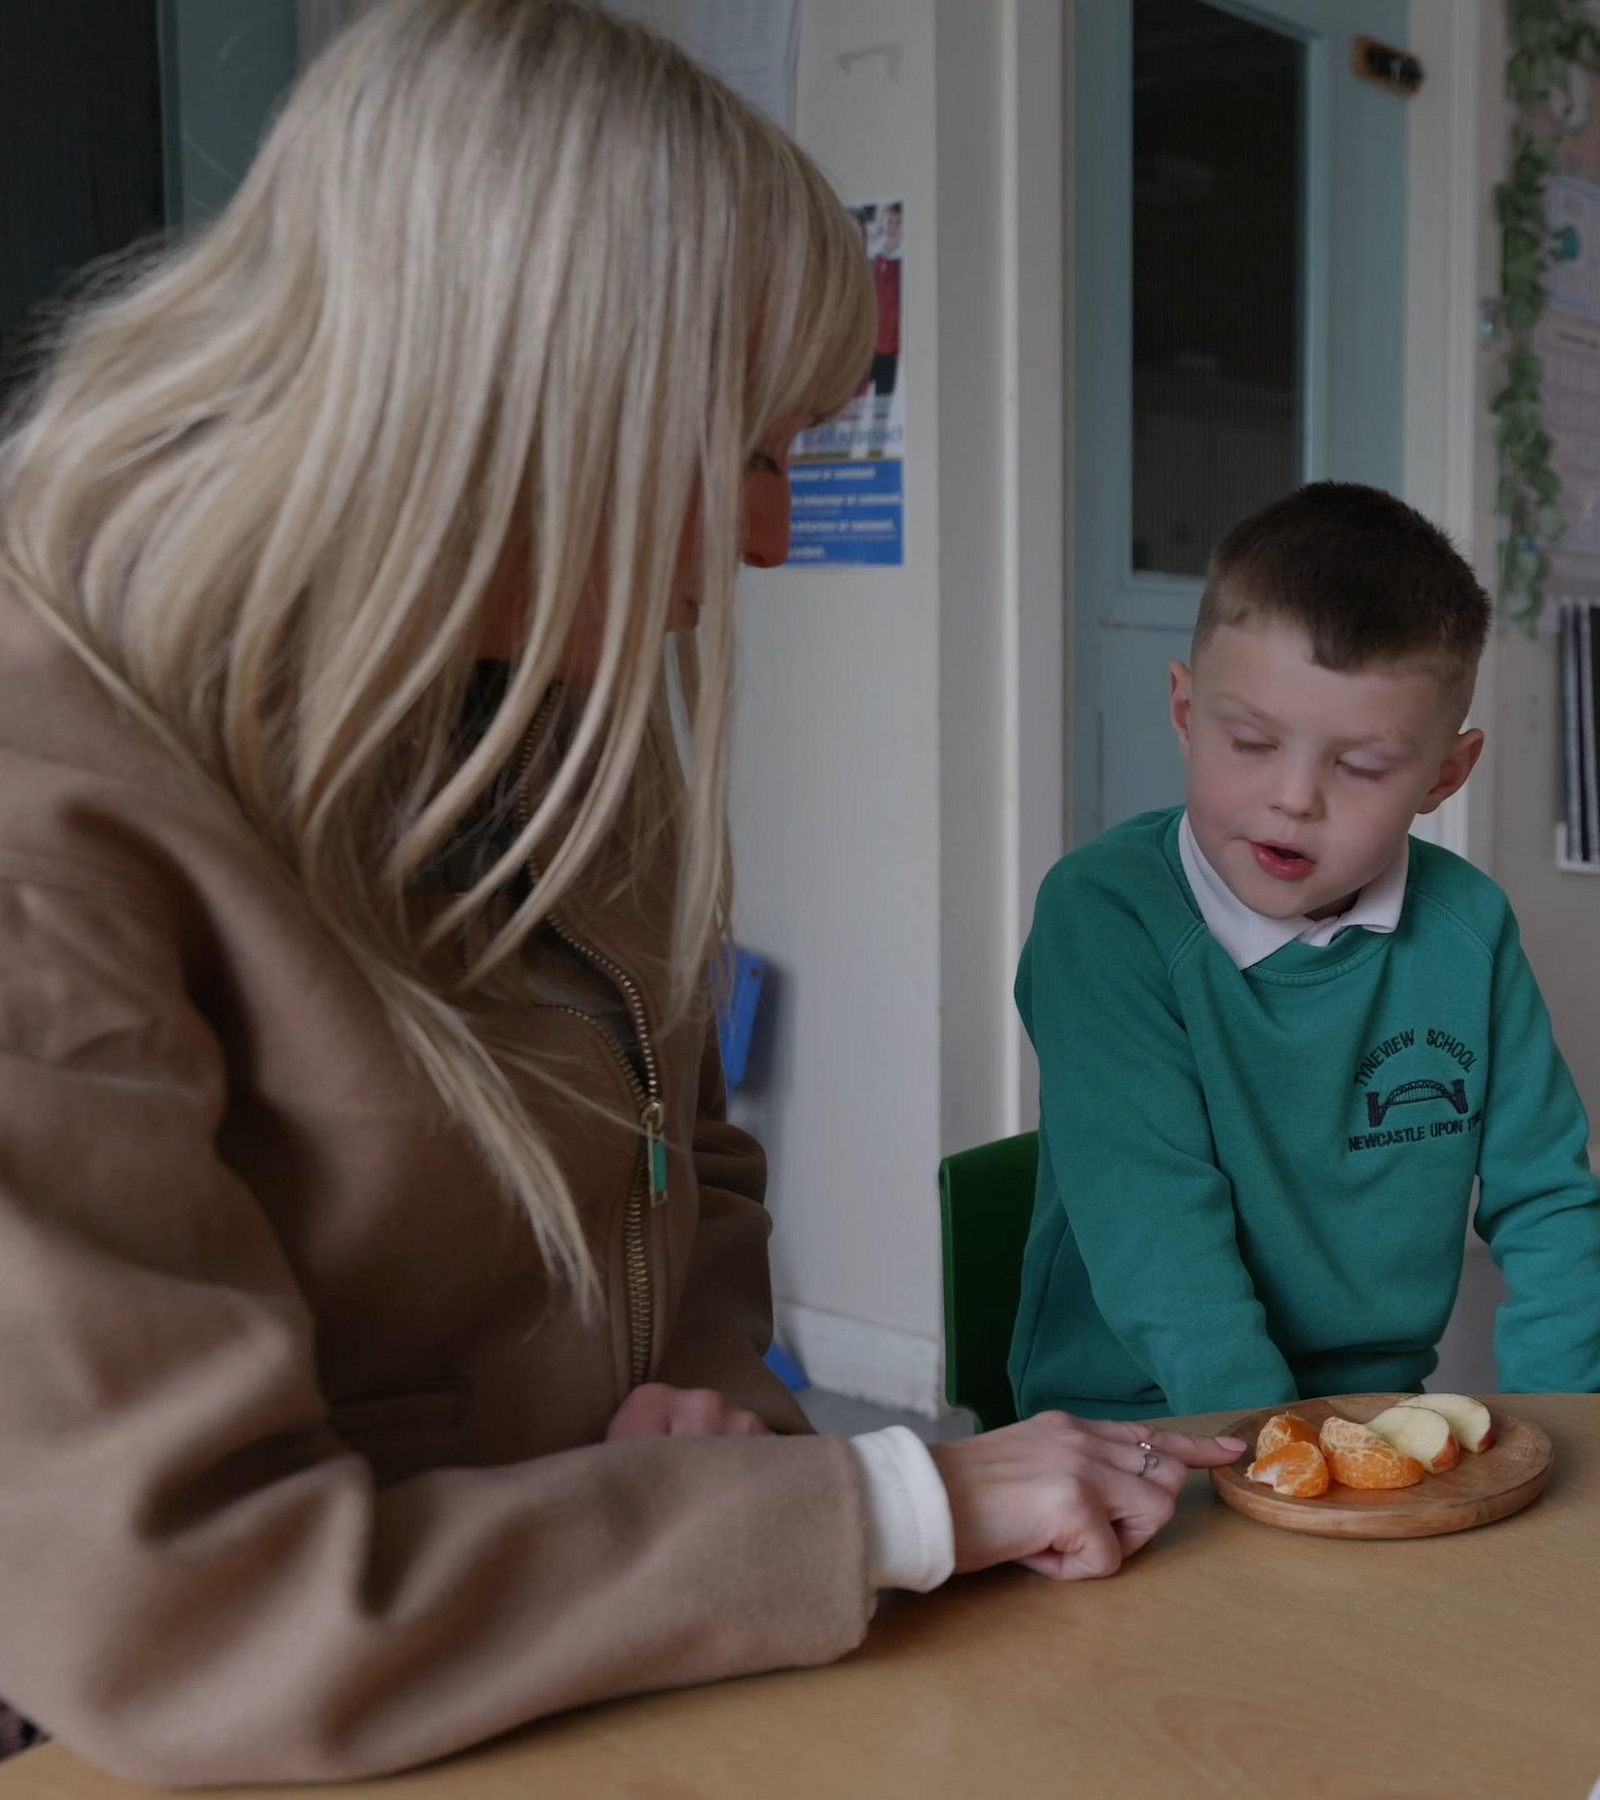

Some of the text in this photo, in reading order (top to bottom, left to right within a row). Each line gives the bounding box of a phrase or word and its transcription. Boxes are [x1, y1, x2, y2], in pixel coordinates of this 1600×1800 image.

[1354, 1028, 1477, 1086] TYNEVIEW SCHOOL
[1348, 1126, 1425, 1152] NEWCASTLE
[1430, 1120, 1463, 1138] UPON
